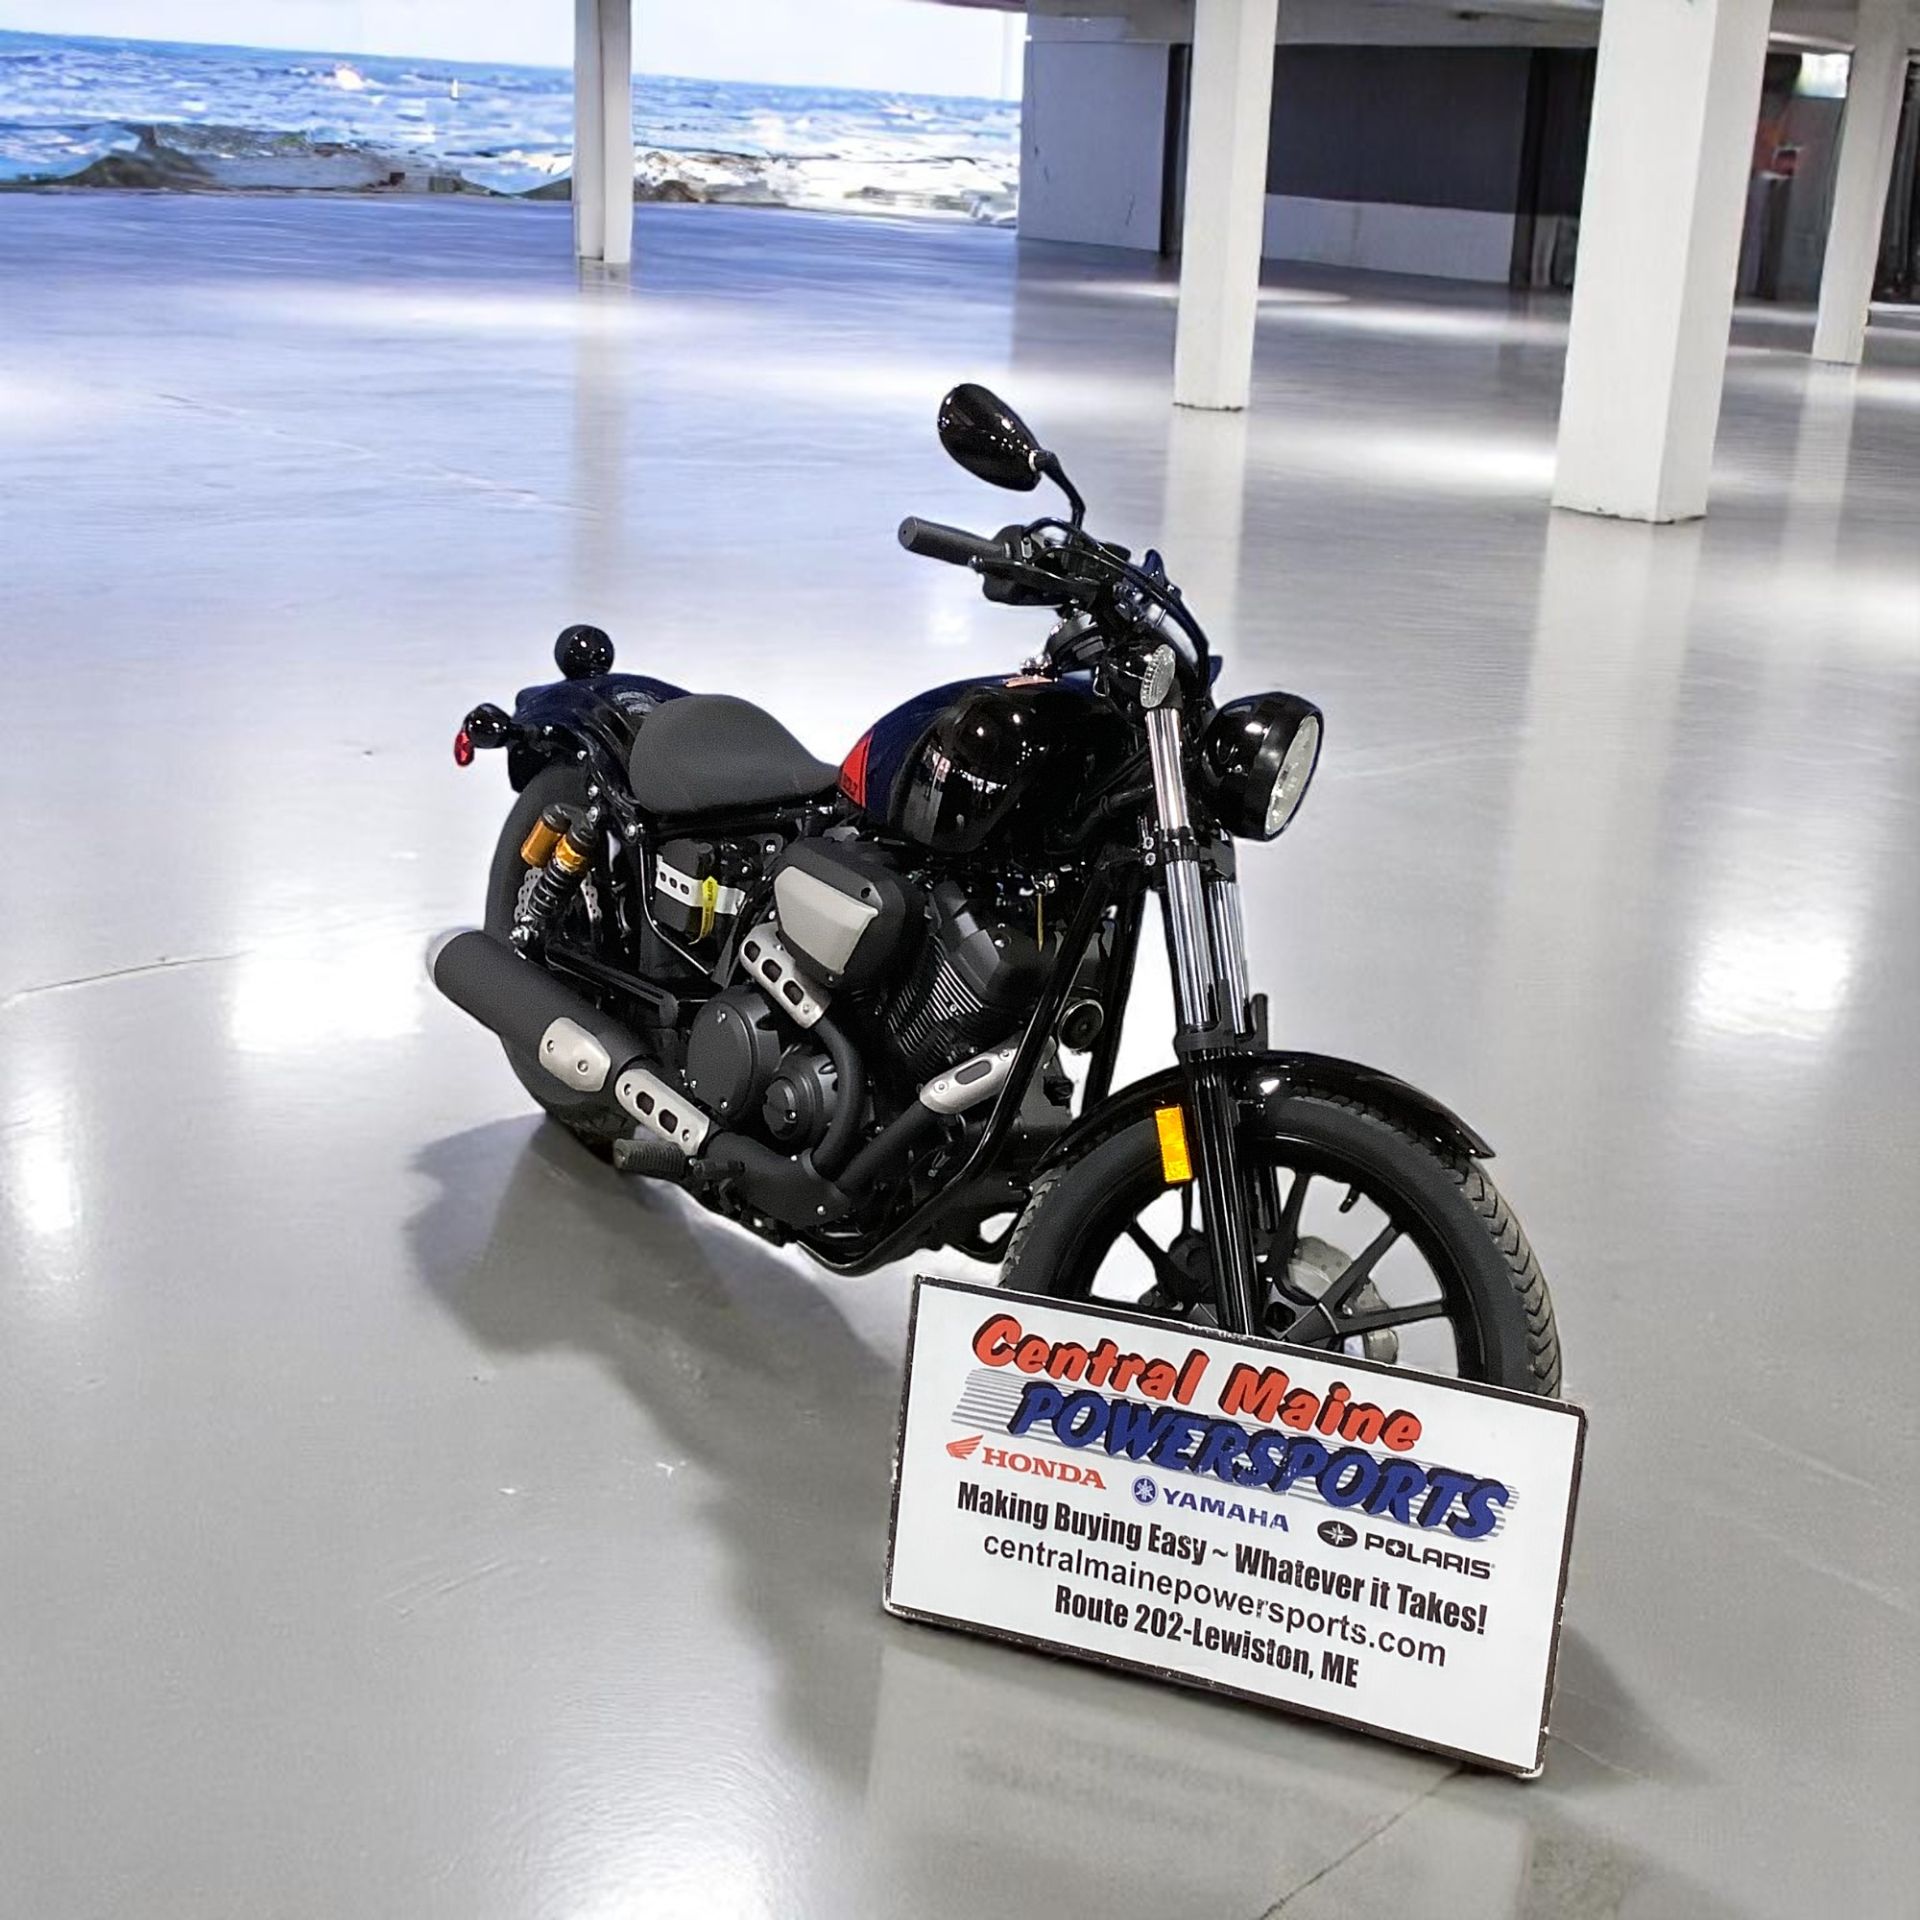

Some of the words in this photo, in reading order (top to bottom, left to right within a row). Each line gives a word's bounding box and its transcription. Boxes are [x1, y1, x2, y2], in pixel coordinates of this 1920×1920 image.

[973, 1313, 1210, 1403] Central
[1218, 1362, 1422, 1451] Maine
[982, 1446, 1107, 1490] HONDA
[1007, 1382, 1509, 1539] POWERSPORTS
[1163, 1488, 1290, 1532] YAMAHA
[957, 1481, 1049, 1530] Making
[1054, 1502, 1142, 1550] Buying
[1147, 1522, 1207, 1565] Easy
[1234, 1544, 1365, 1602] Whatever
[1371, 1577, 1391, 1609] it
[1396, 1582, 1488, 1634] Takes!
[984, 1535, 1446, 1668] centralmainepowersports.com
[1364, 1533, 1492, 1580] POLARIS
[1055, 1585, 1129, 1627] Route
[1134, 1603, 1315, 1680] 202-Lewiston,
[1321, 1651, 1360, 1689] ME
